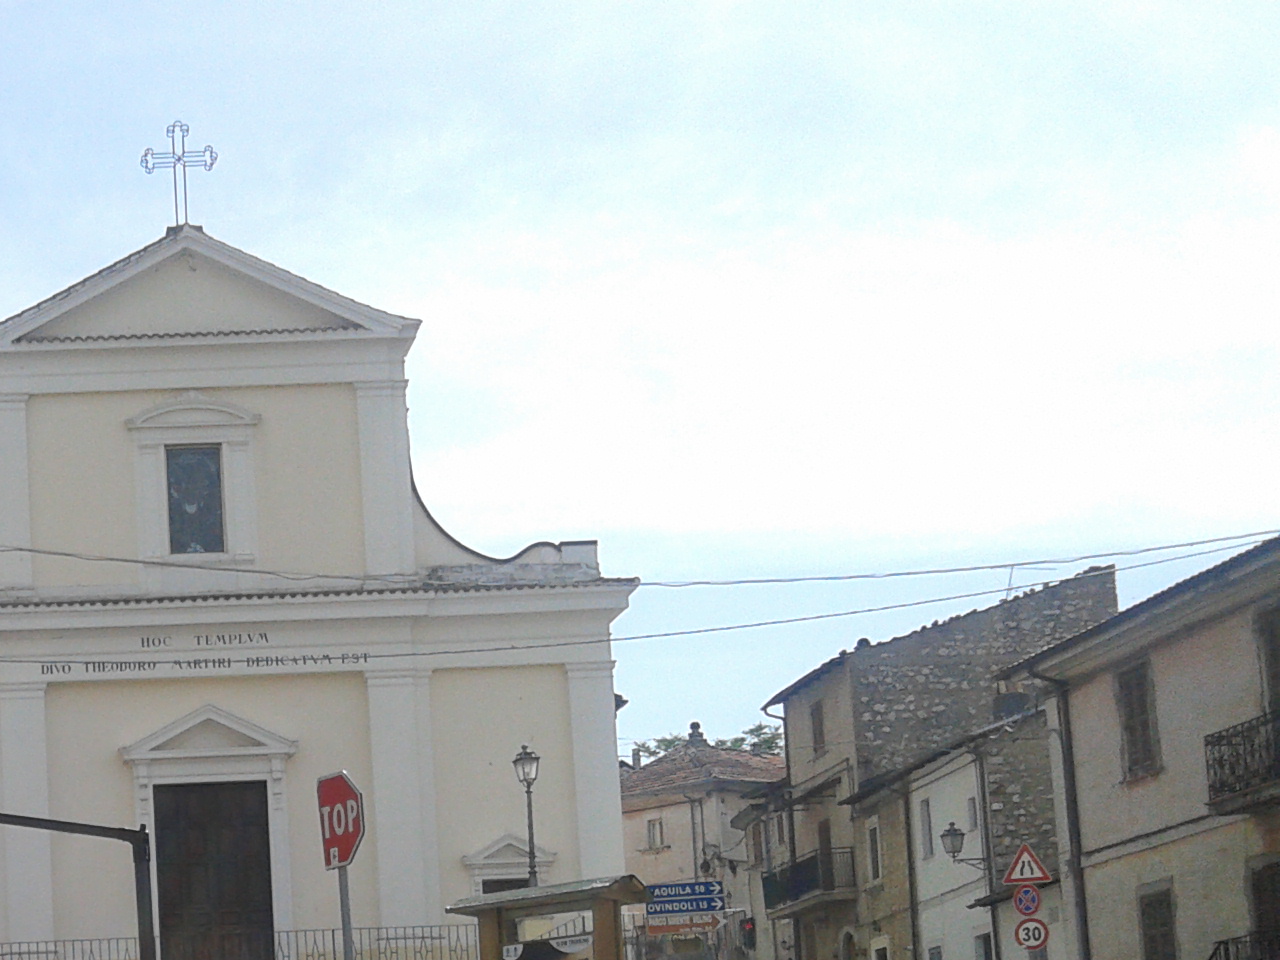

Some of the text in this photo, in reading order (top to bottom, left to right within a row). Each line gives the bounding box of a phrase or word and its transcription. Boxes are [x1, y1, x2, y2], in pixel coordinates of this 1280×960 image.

[140, 632, 270, 648] HOC TEMPLVM
[40, 664, 72, 675] DIVO
[83, 660, 158, 673] THEODORO
[321, 799, 358, 839] TOP
[650, 885, 692, 897] 'AQUILA
[647, 900, 697, 913] OVINDOLI
[1022, 927, 1041, 942] 30
